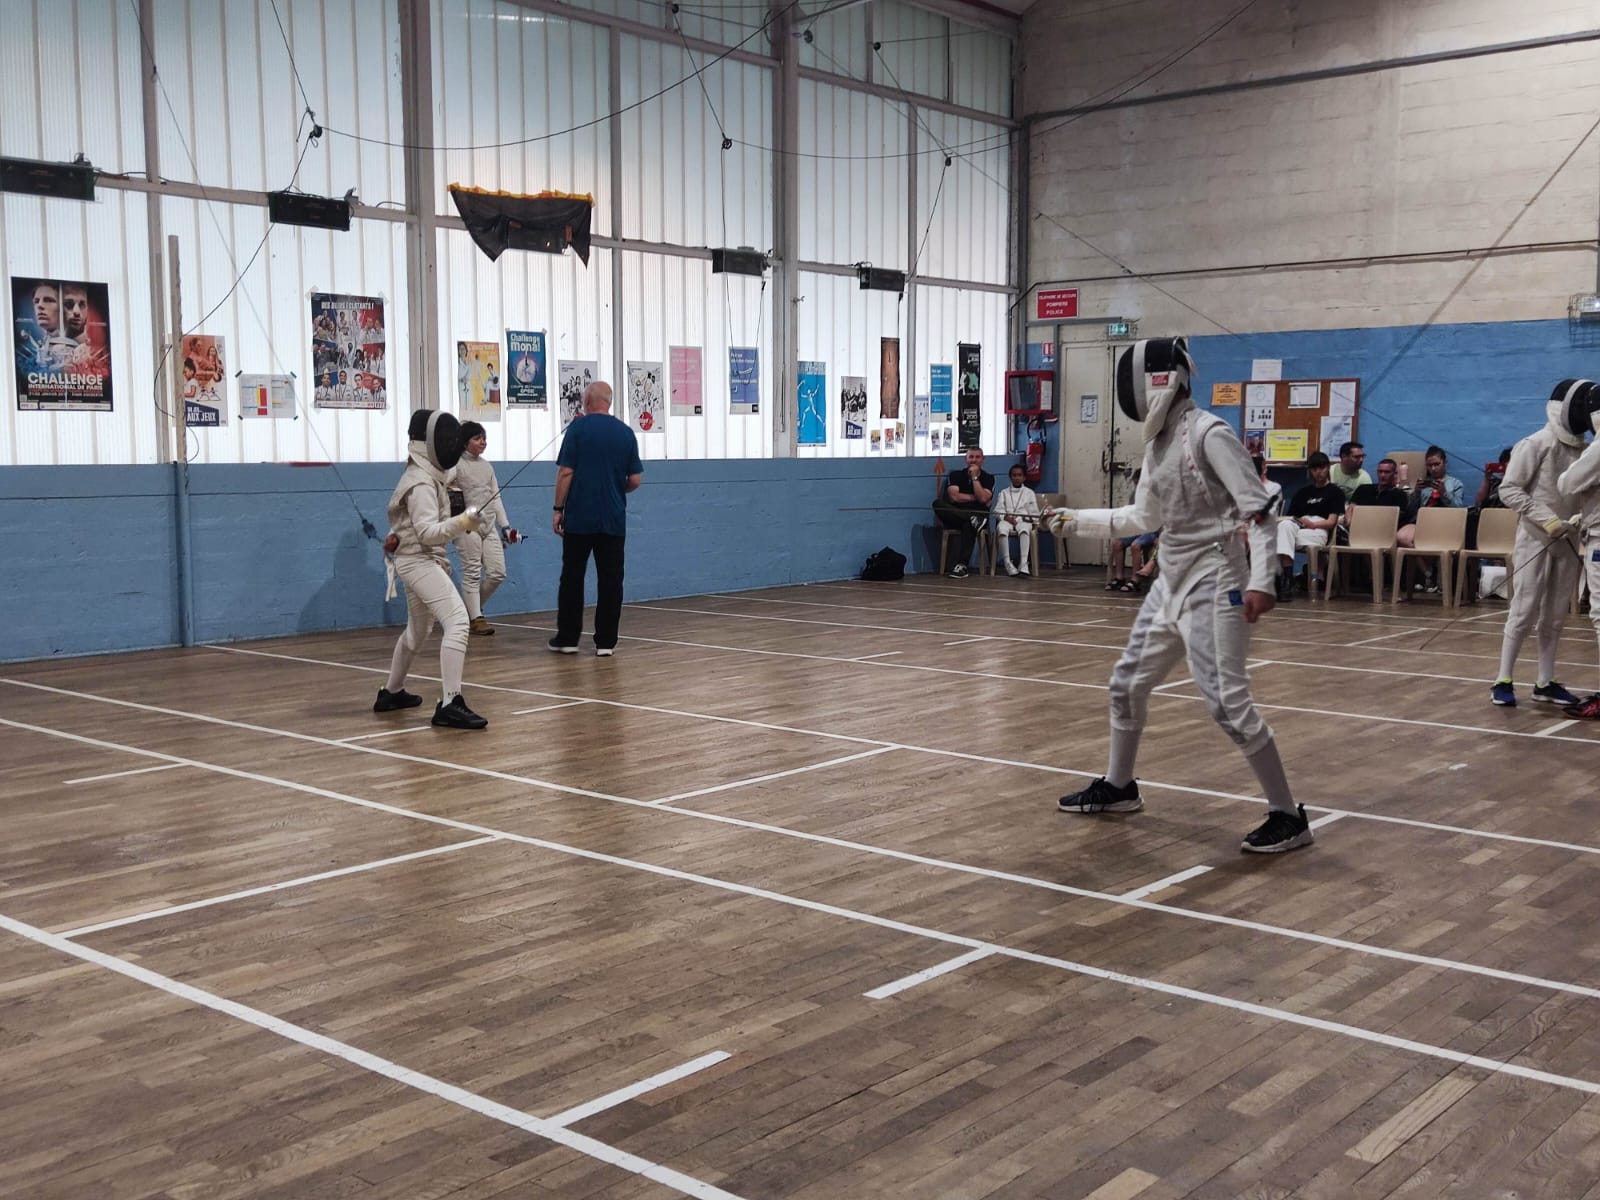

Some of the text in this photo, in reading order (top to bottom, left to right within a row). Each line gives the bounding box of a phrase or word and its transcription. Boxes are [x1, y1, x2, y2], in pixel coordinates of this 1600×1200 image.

[510, 333, 540, 344] Challenge
[510, 342, 540, 353] monal
[28, 373, 103, 385] CHALLENGE
[187, 412, 216, 422] AUX JEUX
